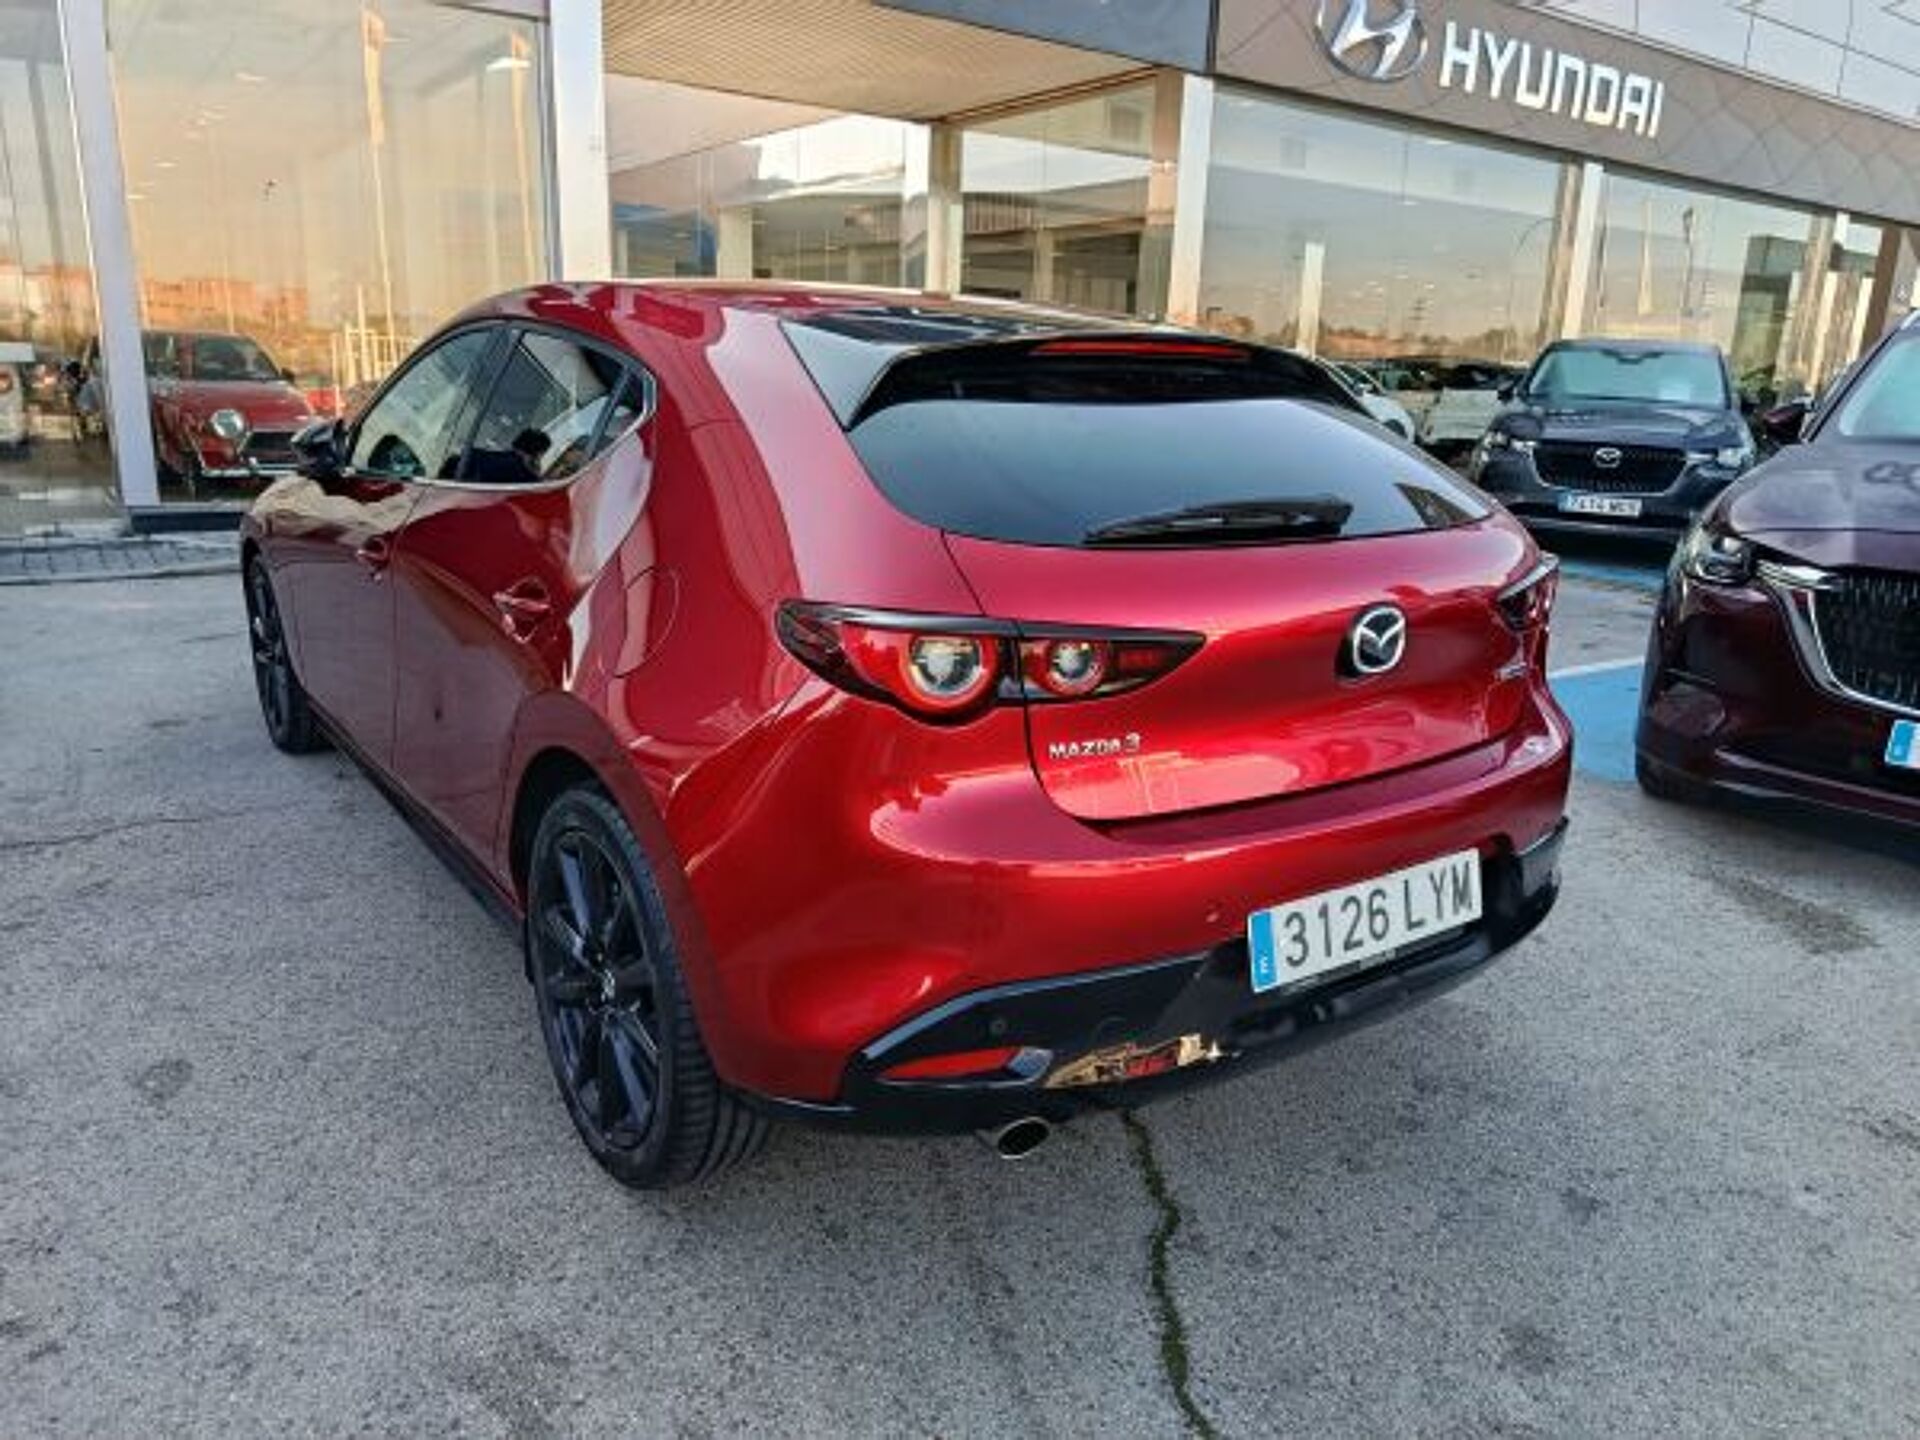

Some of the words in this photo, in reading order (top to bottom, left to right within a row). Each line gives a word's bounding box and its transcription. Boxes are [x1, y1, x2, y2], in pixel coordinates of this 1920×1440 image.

[1439, 21, 1664, 138] HYUNDAI
[1048, 738, 1121, 759] MAZDA
[1125, 731, 1141, 753] 3
[1283, 888, 1390, 968] 3126
[1403, 860, 1473, 932] LYM
